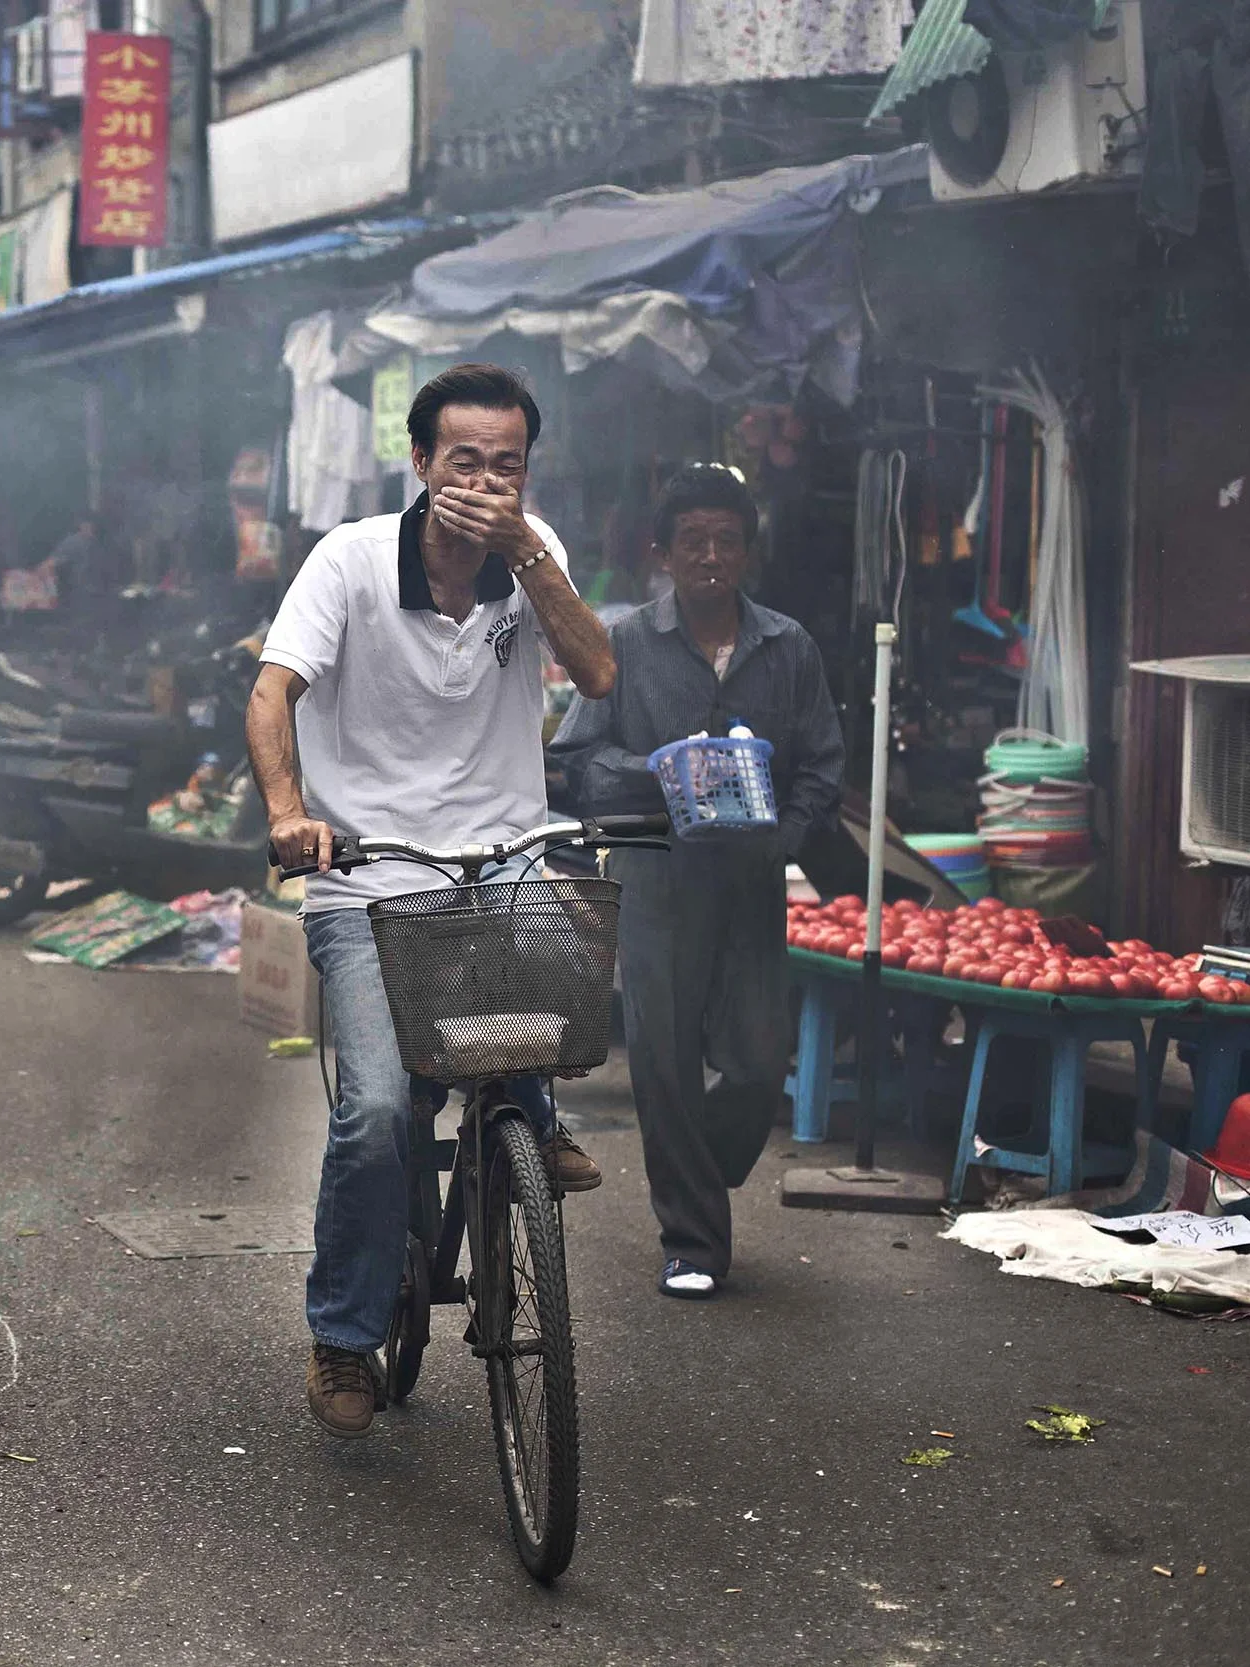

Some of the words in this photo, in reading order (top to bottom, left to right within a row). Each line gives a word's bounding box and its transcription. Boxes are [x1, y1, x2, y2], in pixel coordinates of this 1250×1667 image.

[93, 45, 159, 237] 小苏州炒货店
